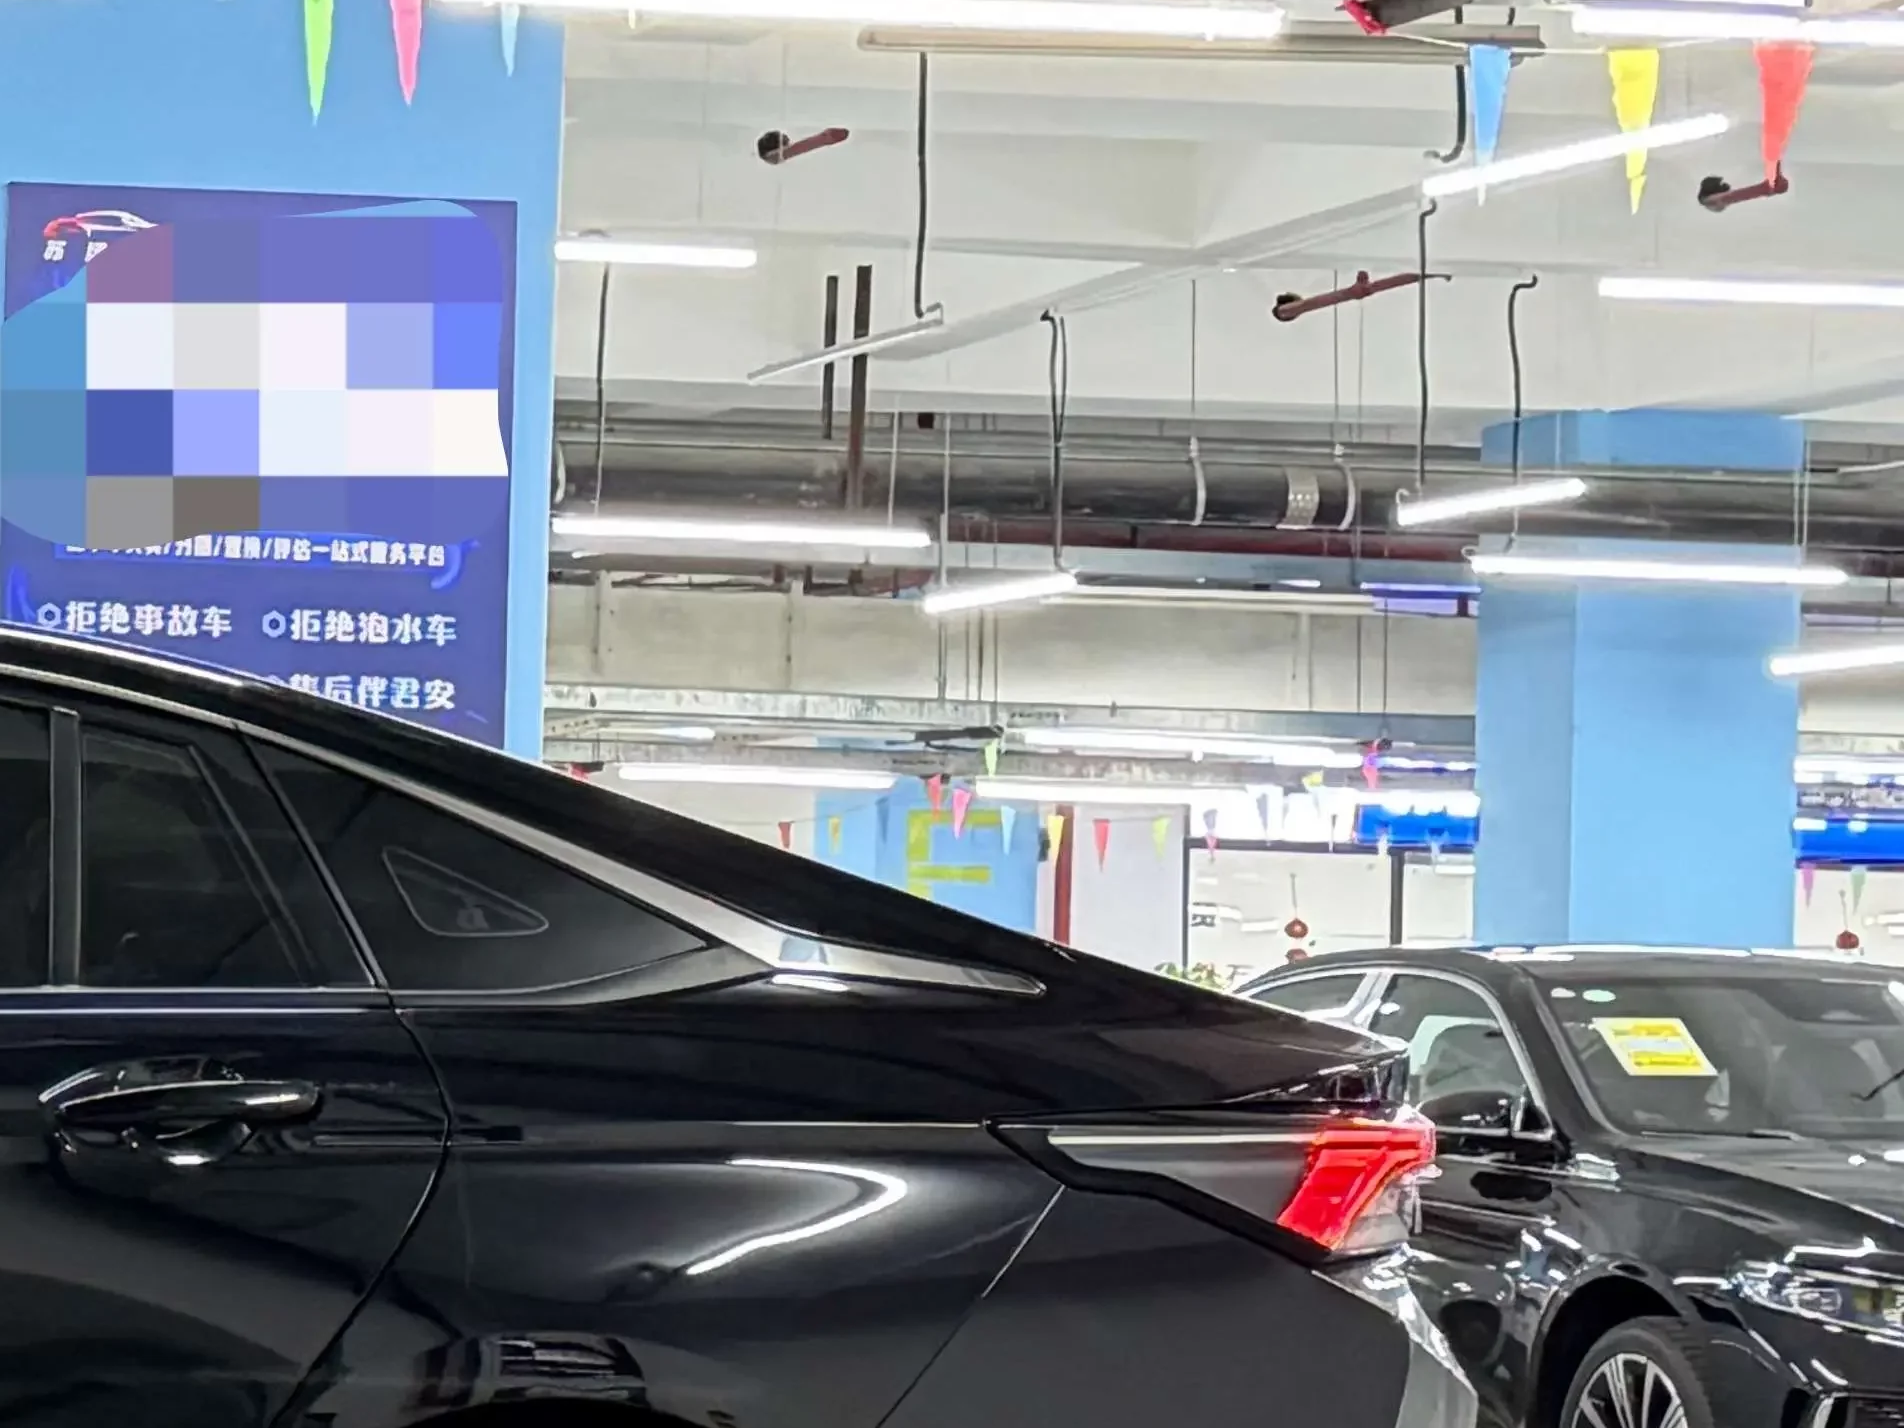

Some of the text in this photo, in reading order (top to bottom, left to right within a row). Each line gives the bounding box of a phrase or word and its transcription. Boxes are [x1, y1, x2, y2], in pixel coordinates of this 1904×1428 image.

[65, 600, 232, 638] 拒绝事故车
[290, 609, 457, 647] 拒绝泡水车
